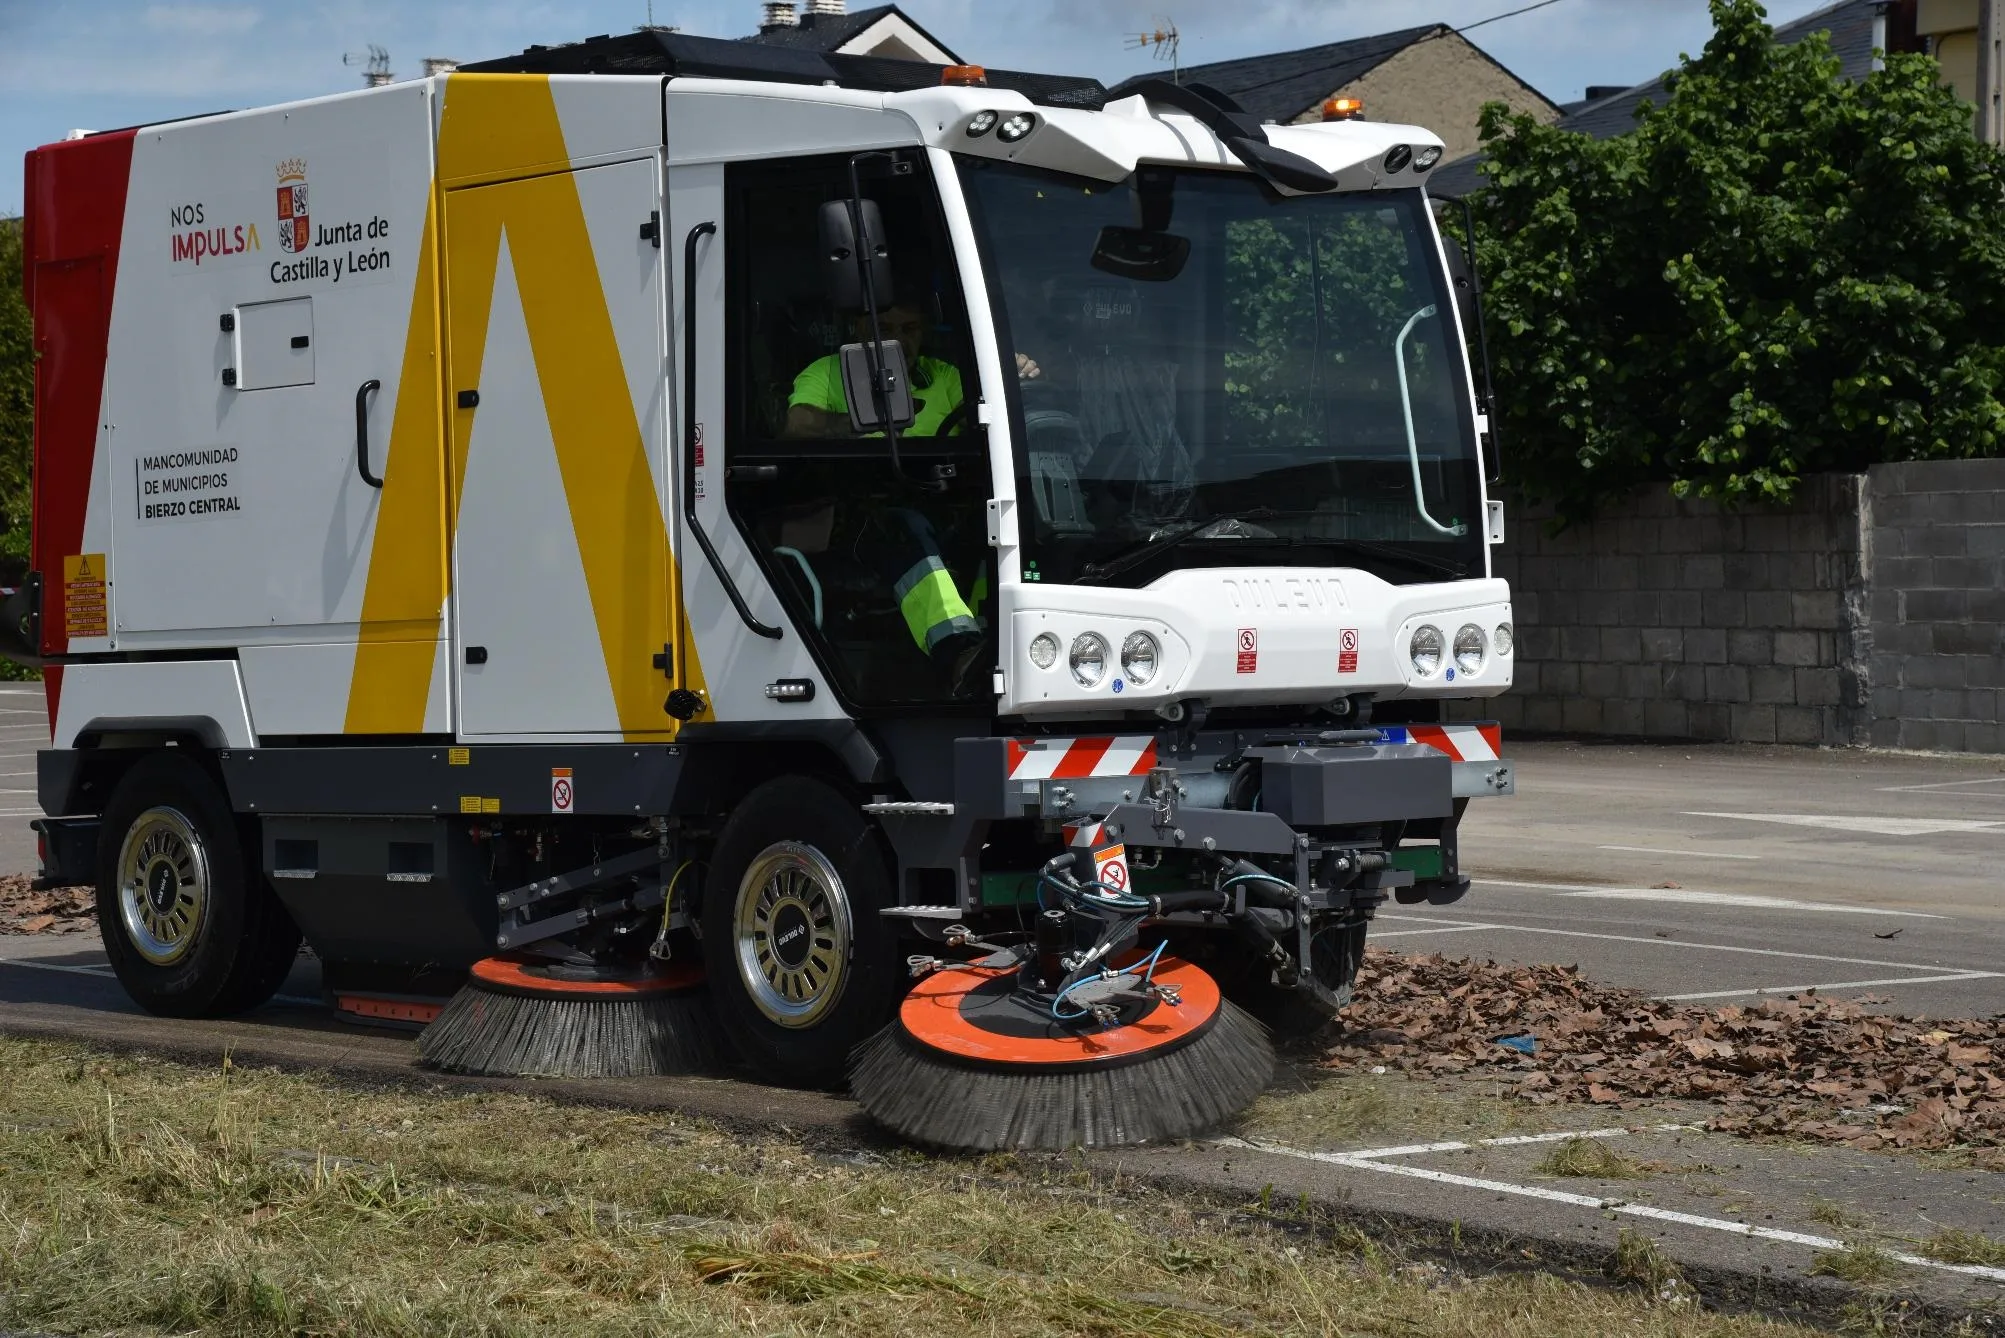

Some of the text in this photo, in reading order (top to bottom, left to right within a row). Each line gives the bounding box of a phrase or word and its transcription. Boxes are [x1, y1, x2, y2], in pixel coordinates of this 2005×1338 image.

[171, 204, 204, 227] NOS
[314, 216, 389, 247] Junta de
[270, 247, 390, 283] Castilla y León
[143, 448, 238, 471] MANCOMUNIDAD
[144, 473, 228, 495] DE MUNICIPIOS
[145, 496, 240, 519] BIERZO CENTRAL
[1222, 579, 1351, 613] DULEVO
